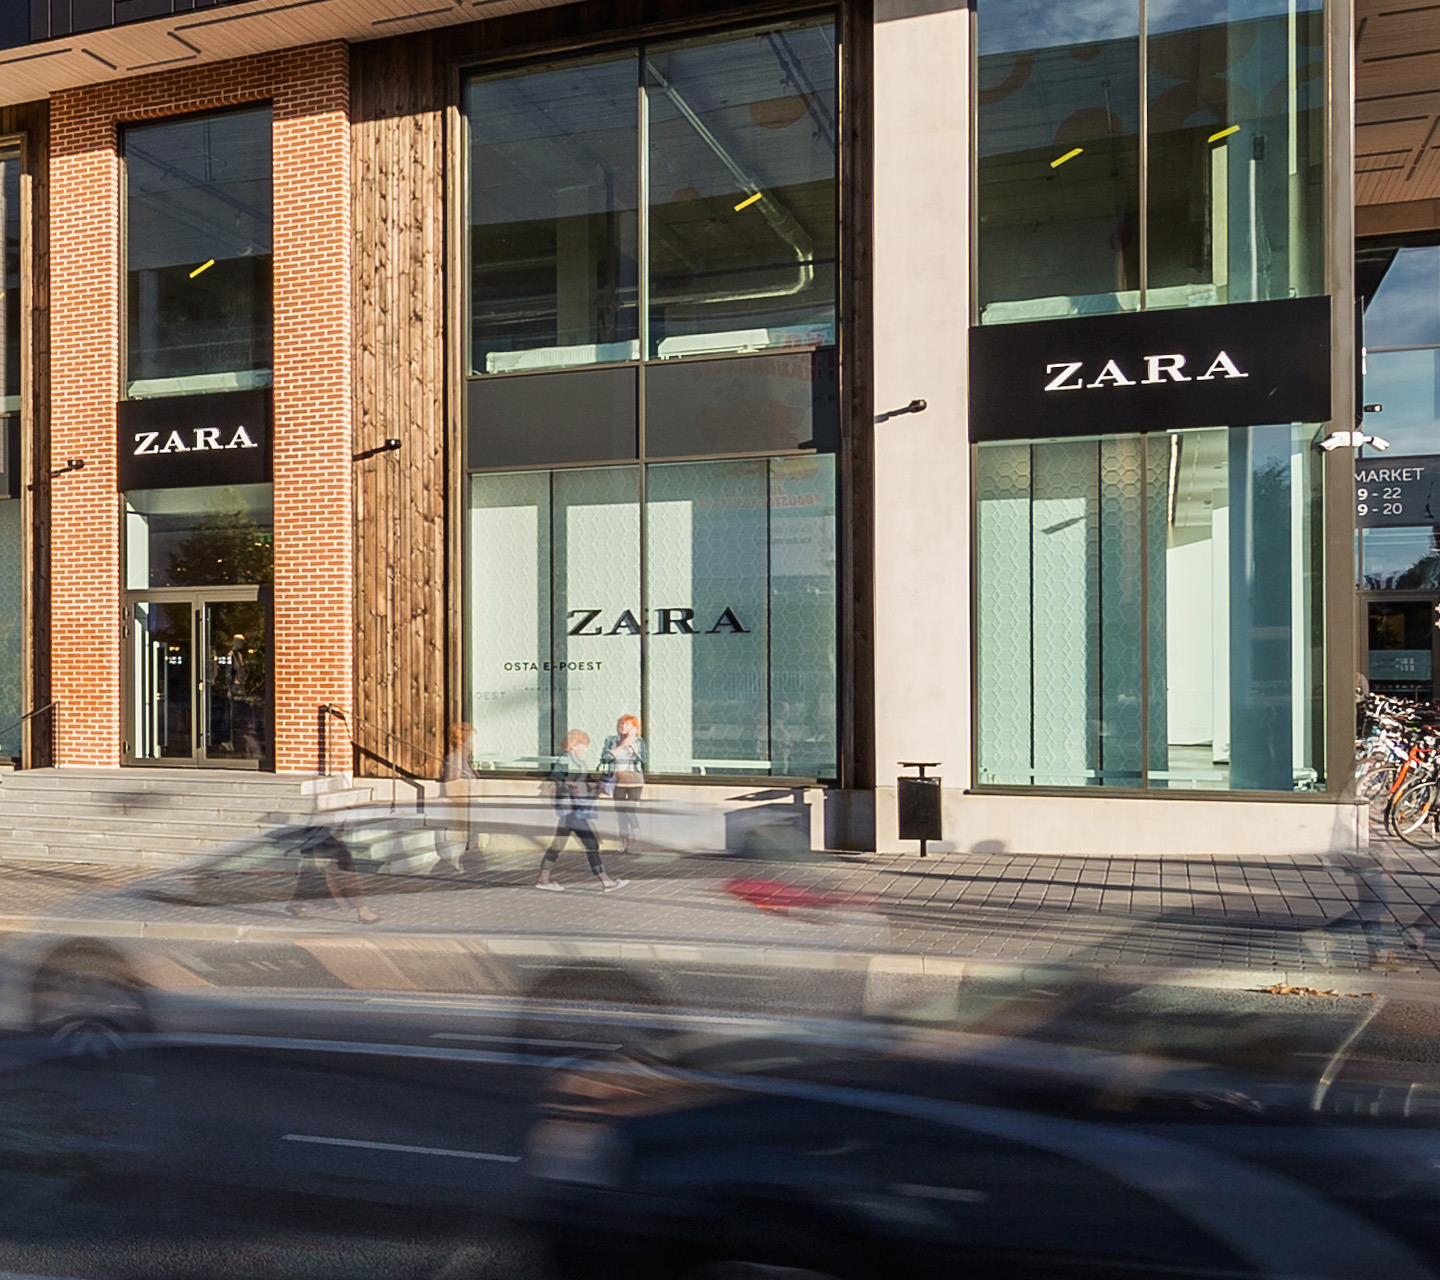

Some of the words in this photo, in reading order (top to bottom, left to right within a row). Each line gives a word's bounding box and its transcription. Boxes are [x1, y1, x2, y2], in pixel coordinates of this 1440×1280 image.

[1044, 350, 1249, 391] ZARA
[133, 425, 259, 456] ZARA
[1357, 488, 1368, 500] 9
[1382, 487, 1402, 499] 22
[1357, 503, 1368, 516] 9
[1382, 502, 1403, 515] 20
[567, 606, 752, 636] ZARA
[504, 661, 538, 671] OSTA
[543, 661, 602, 671] E-POEST
